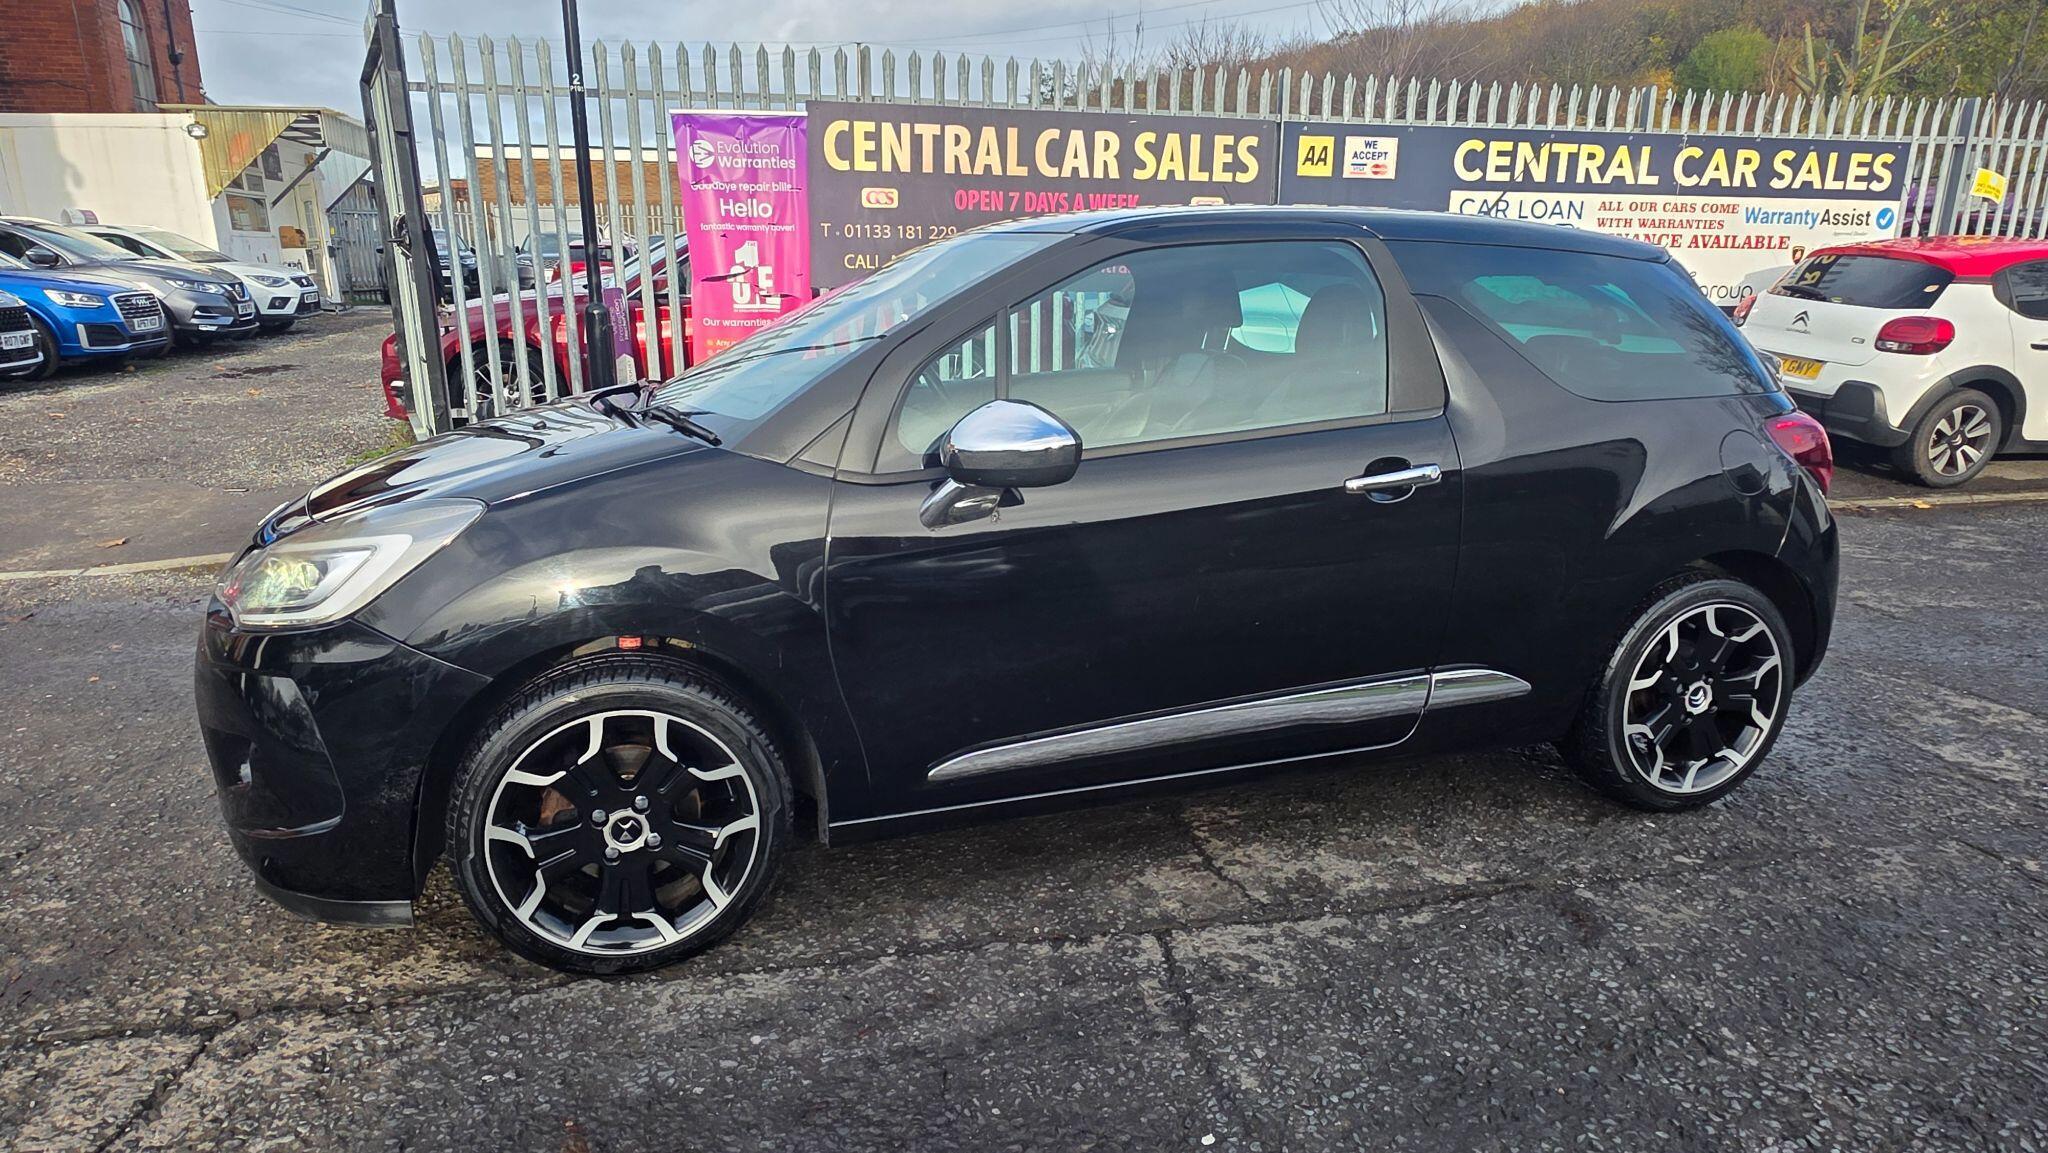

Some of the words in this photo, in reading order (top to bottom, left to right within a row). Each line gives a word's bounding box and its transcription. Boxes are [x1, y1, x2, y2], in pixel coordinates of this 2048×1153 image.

[572, 73, 580, 85] 2
[716, 141, 780, 154] Evolution
[823, 119, 1029, 177] CENTRAL
[1034, 128, 1121, 179] CAR
[1132, 131, 1260, 184] SALES
[1364, 140, 1379, 149] WE
[718, 155, 797, 169] Warranties
[1302, 145, 1329, 167] AA
[1352, 151, 1389, 160] ACCEPT
[1453, 139, 1660, 186] CENTRAL
[1673, 146, 1761, 188] CAR
[1769, 149, 1896, 192] SALES
[738, 182, 770, 194] repair
[954, 189, 1004, 211] OPEN
[1009, 191, 1020, 212] 7
[1024, 191, 1069, 213] DAYS
[1073, 193, 1085, 211] A
[1089, 193, 1140, 210] WEEK
[1598, 201, 1624, 212] ALL
[1629, 201, 1658, 213] OUR
[1662, 202, 1697, 214] CARS
[1700, 203, 1740, 214] COME
[719, 198, 774, 219] Hello
[1459, 197, 1510, 218] CAR
[1518, 199, 1584, 220] LOAN
[1597, 217, 1634, 228] WITH
[1638, 217, 1726, 230] WARRANTIES
[844, 223, 892, 239] 01133
[898, 225, 923, 240] 181
[1687, 233, 1791, 250] AVAILABLE
[702, 317, 721, 328] Our
